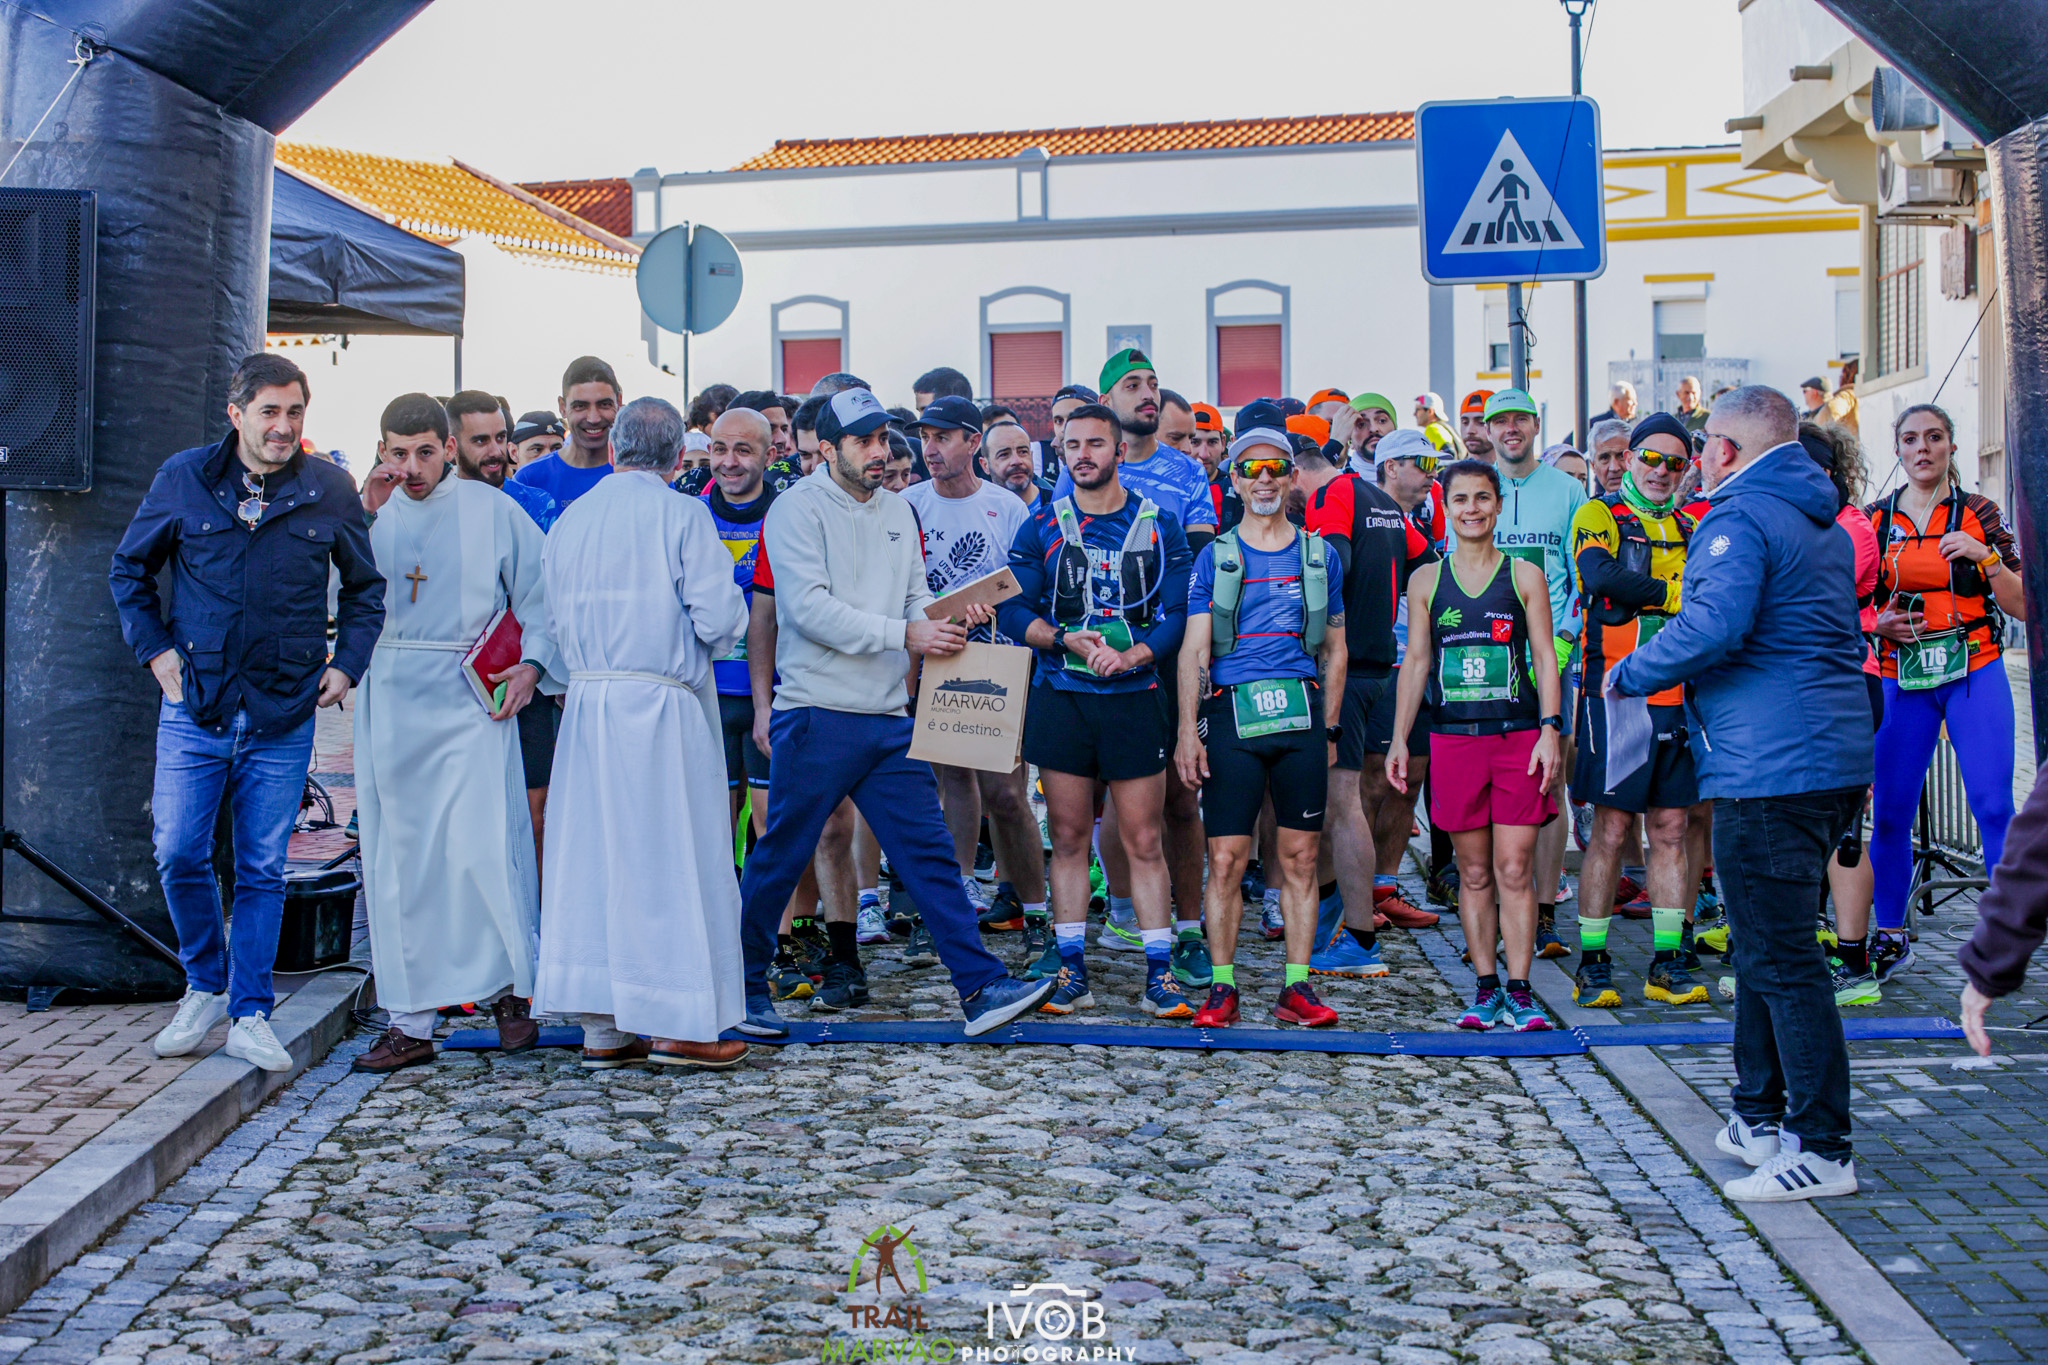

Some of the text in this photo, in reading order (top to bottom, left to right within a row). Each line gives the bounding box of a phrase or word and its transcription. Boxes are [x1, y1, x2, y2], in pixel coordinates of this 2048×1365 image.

[938, 560, 957, 580] UTSM
[1462, 657, 1486, 678] 53
[1917, 646, 1948, 668] 176
[931, 691, 1006, 712] MARVÃO
[1252, 688, 1288, 713] 188
[927, 718, 1004, 738] é o destino.
